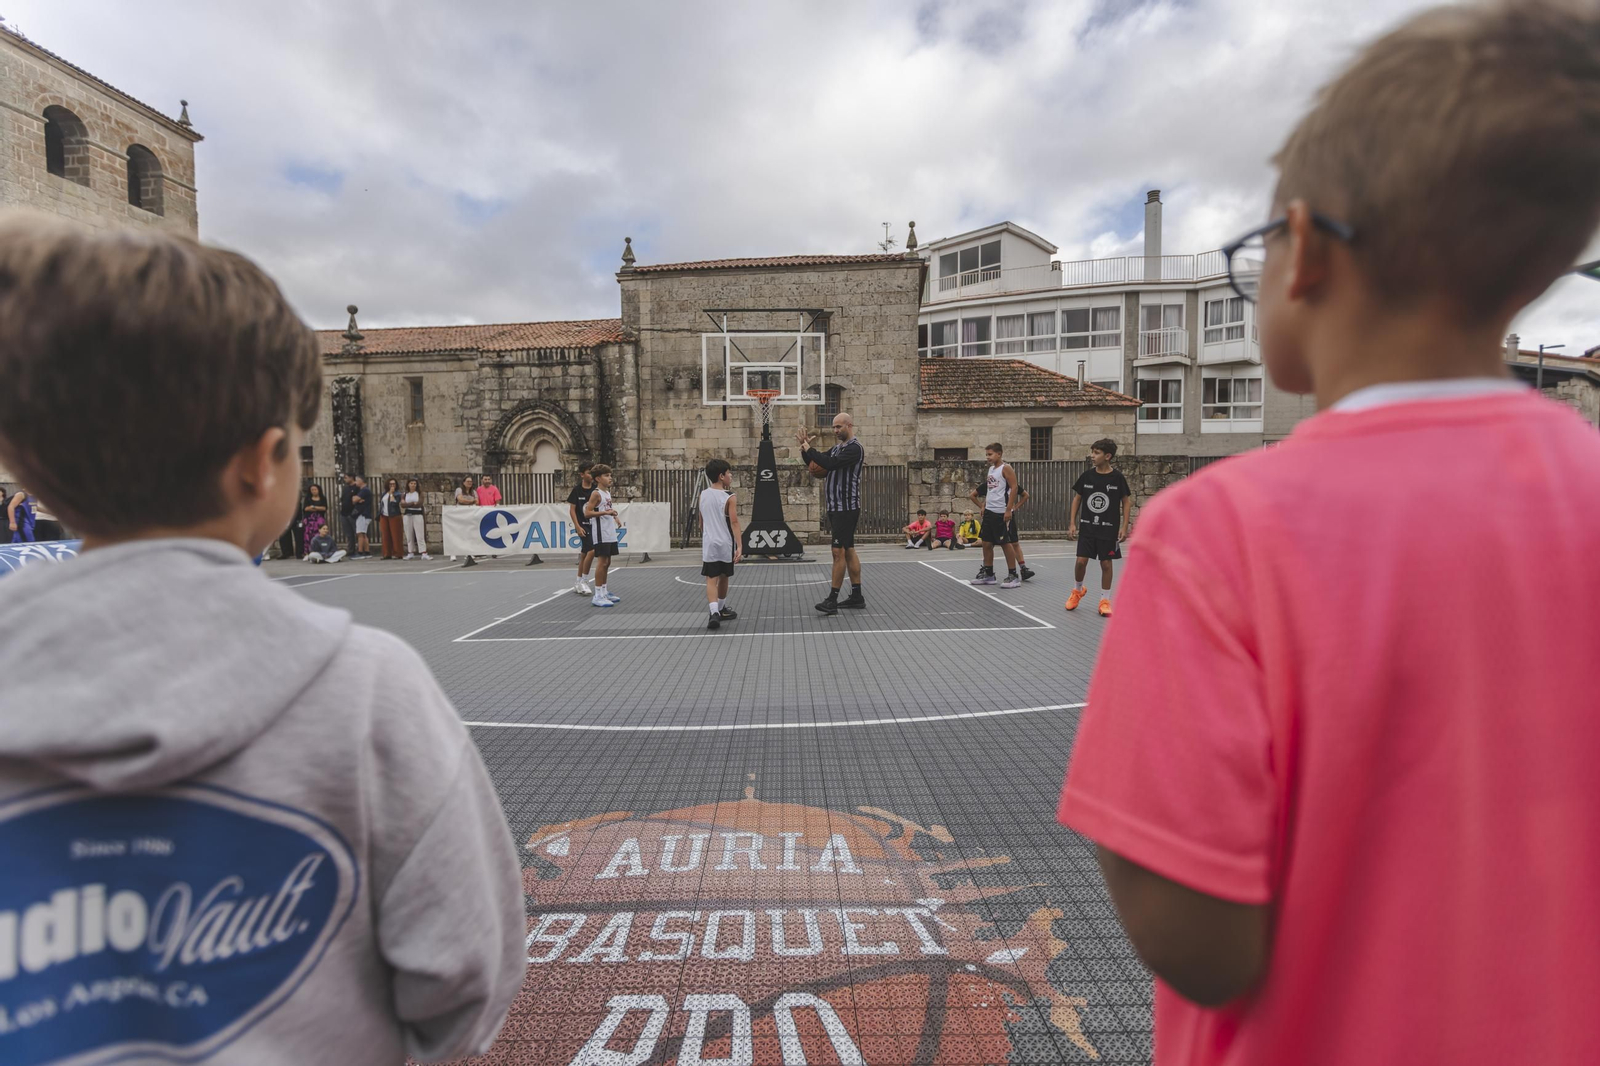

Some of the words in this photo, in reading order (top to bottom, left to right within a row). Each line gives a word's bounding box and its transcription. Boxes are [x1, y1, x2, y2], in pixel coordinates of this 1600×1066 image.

[523, 521, 628, 548] Allaz
[595, 832, 864, 879] AURIA
[526, 908, 949, 963] BASQUET
